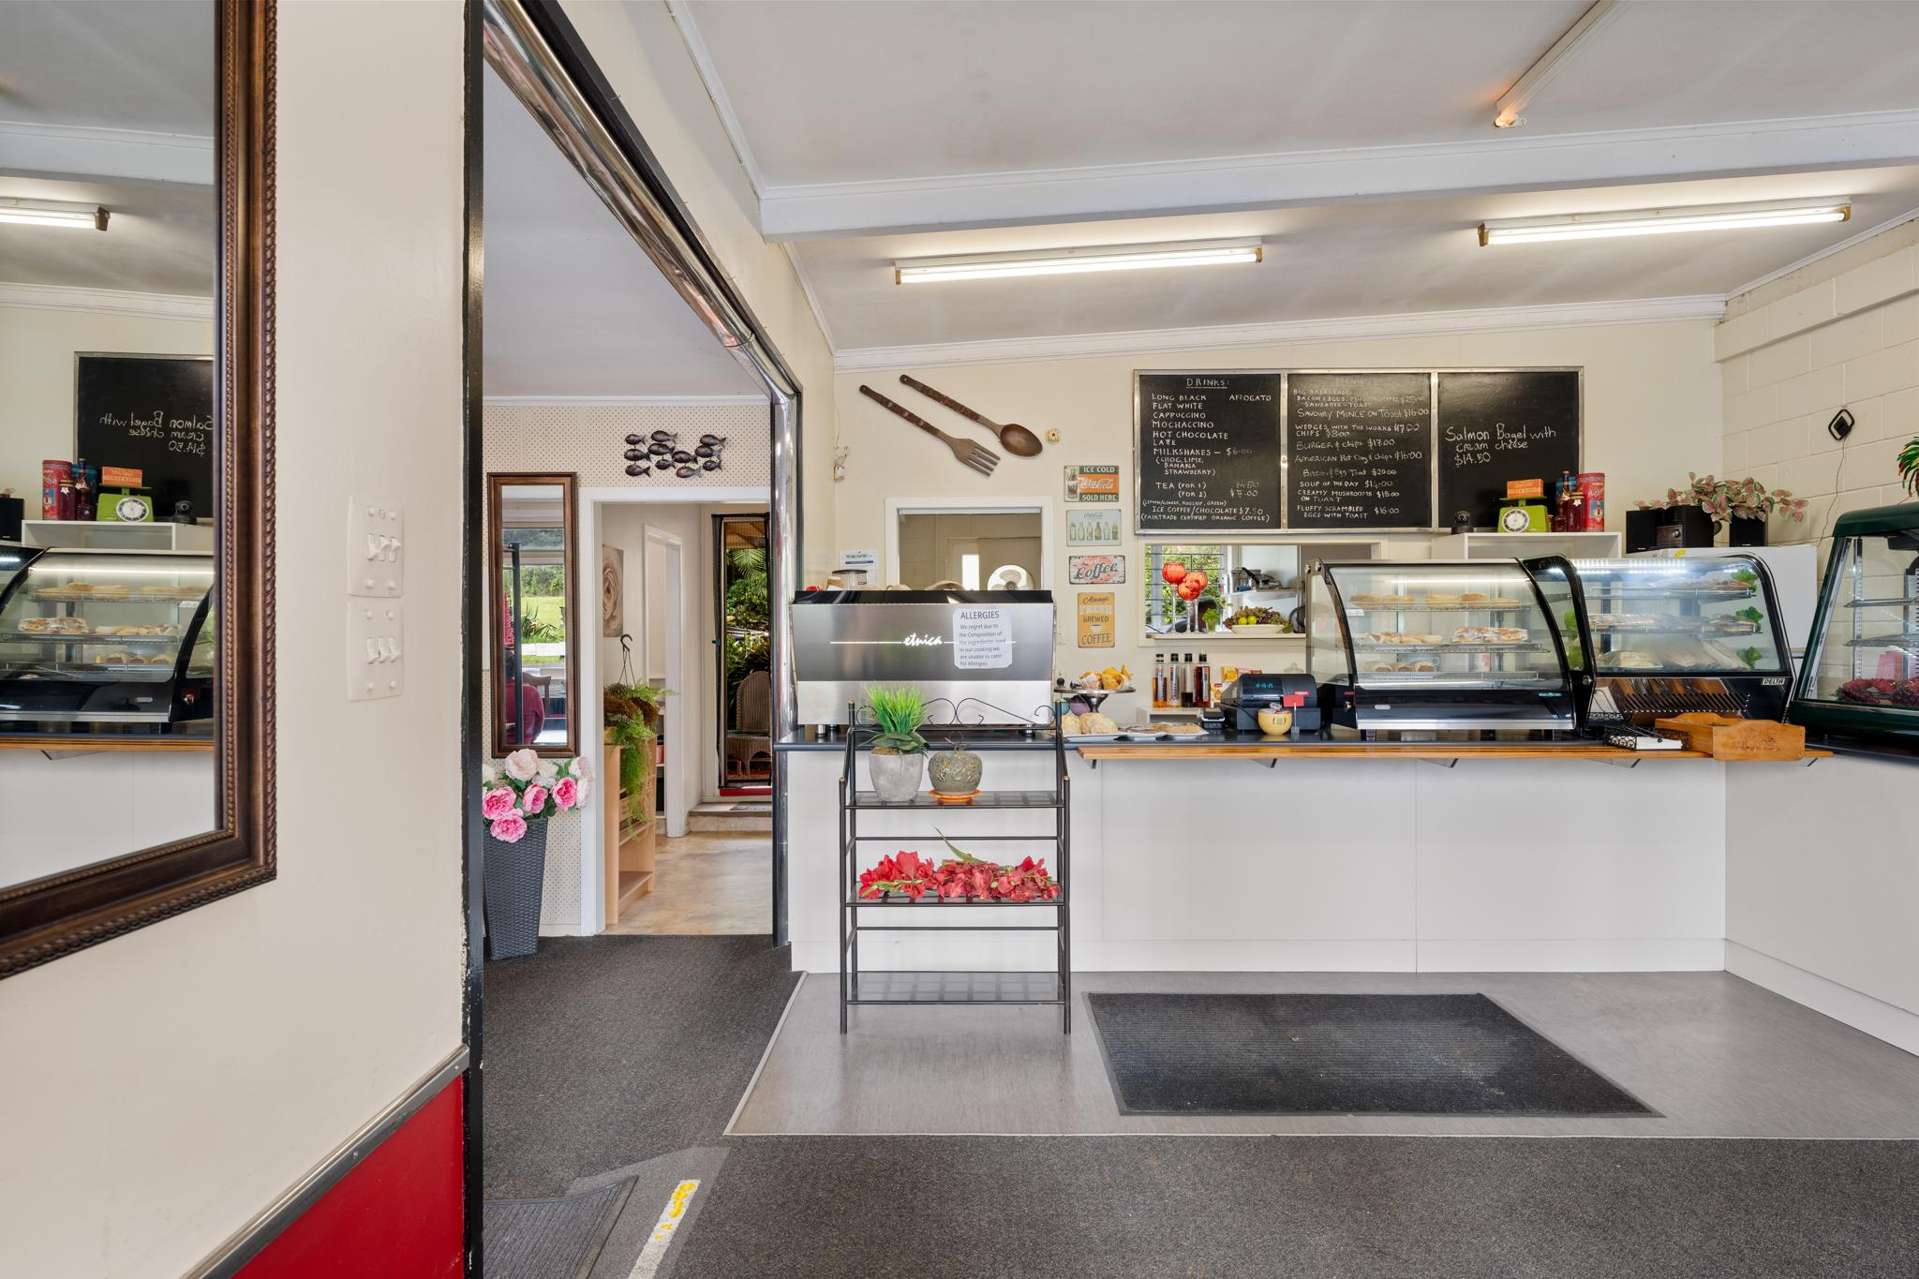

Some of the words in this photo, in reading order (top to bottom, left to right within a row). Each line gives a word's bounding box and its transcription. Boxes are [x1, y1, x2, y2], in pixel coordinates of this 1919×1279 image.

[1152, 402, 1172, 410] FLAT
[1152, 421, 1214, 429] MOCHACCINO
[1152, 431, 1172, 439] HOT
[1176, 431, 1229, 440] CHOCOLATE
[1445, 426, 1490, 441] Salmon
[1496, 423, 1526, 440] Bagel
[1530, 425, 1557, 439] with
[1456, 442, 1489, 452] cream
[1153, 448, 1211, 456] MILKSHAKES
[1455, 452, 1491, 467] $14.50
[960, 610, 1000, 620] ALLERGIES
